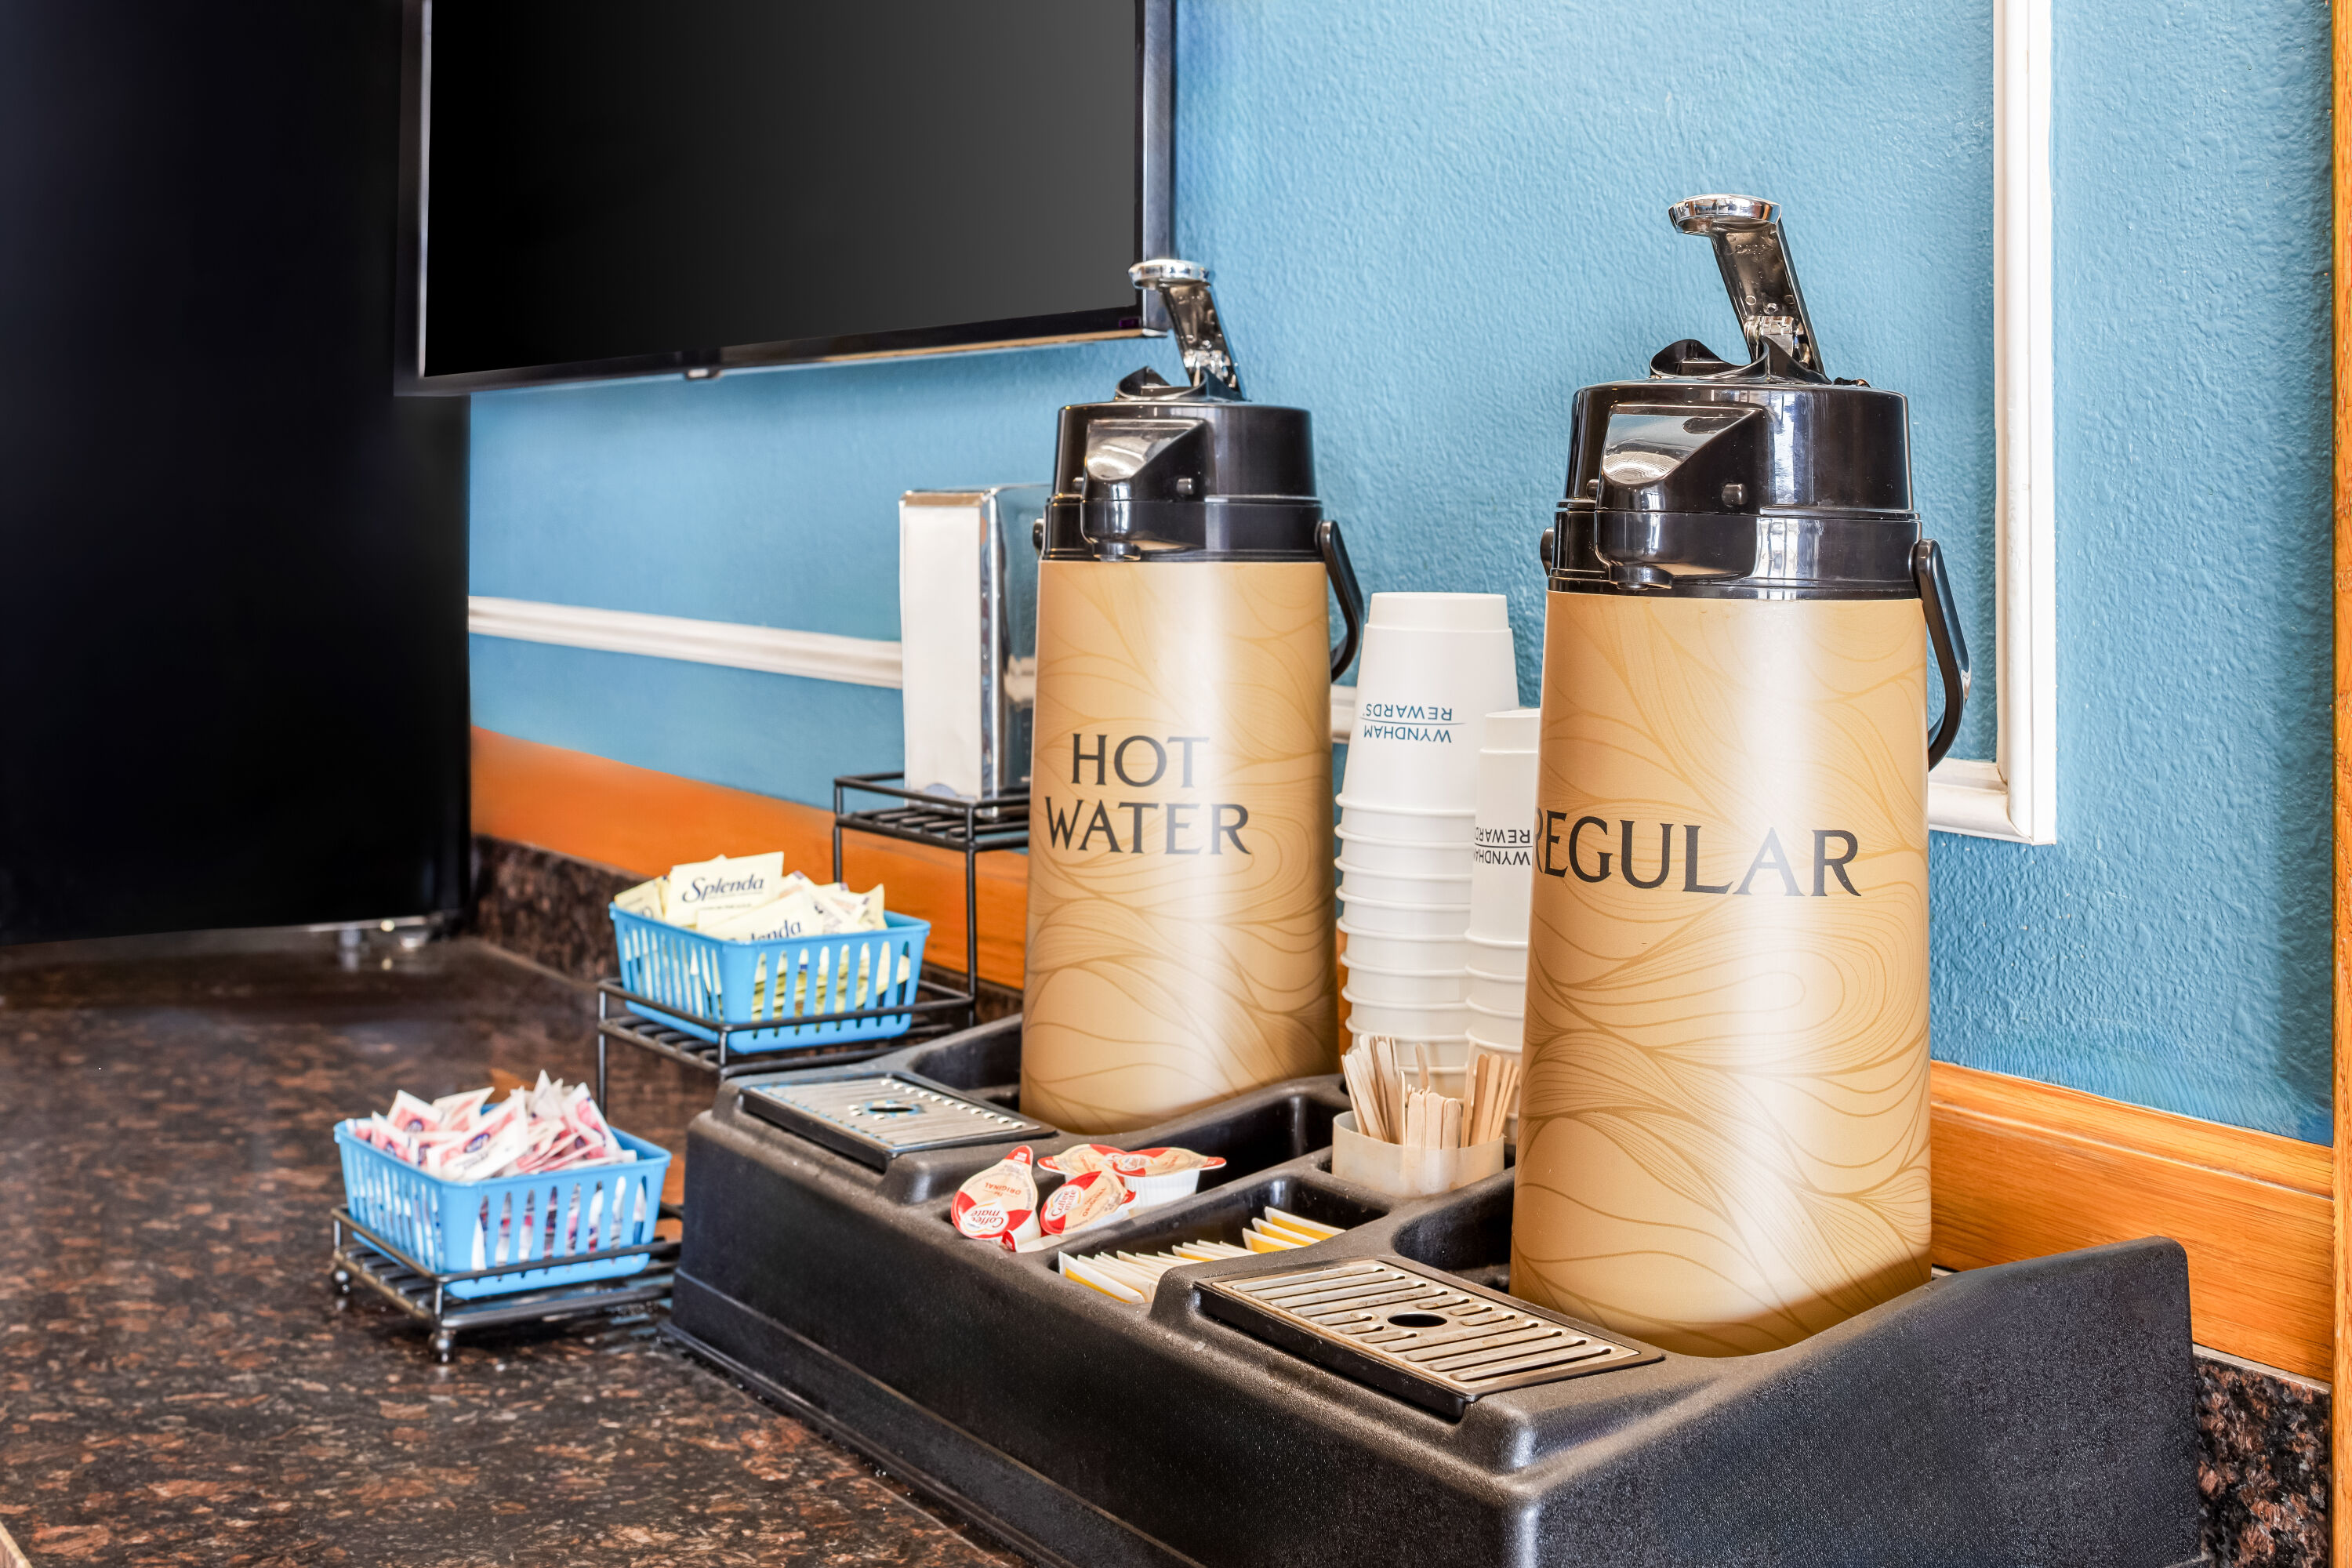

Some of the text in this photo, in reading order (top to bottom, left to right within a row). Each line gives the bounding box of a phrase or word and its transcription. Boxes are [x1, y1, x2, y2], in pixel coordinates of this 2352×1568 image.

[1365, 703, 1453, 721] REWARDS
[1363, 724, 1452, 743] WYNDHAM
[1071, 733, 1210, 788] HOT
[1045, 797, 1252, 855] WATER
[1475, 827, 1530, 844] REWARD
[1474, 848, 1531, 866] WYNDHA
[682, 873, 764, 902] Splenda
[985, 1182, 1022, 1196] ORIGINAL
[1051, 1191, 1069, 1218] Coffee
[1064, 1189, 1076, 1210] mate
[1081, 1186, 1107, 1217] ORIGINAL
[971, 1210, 1000, 1218] mate
[971, 1216, 1004, 1229] Coffee
